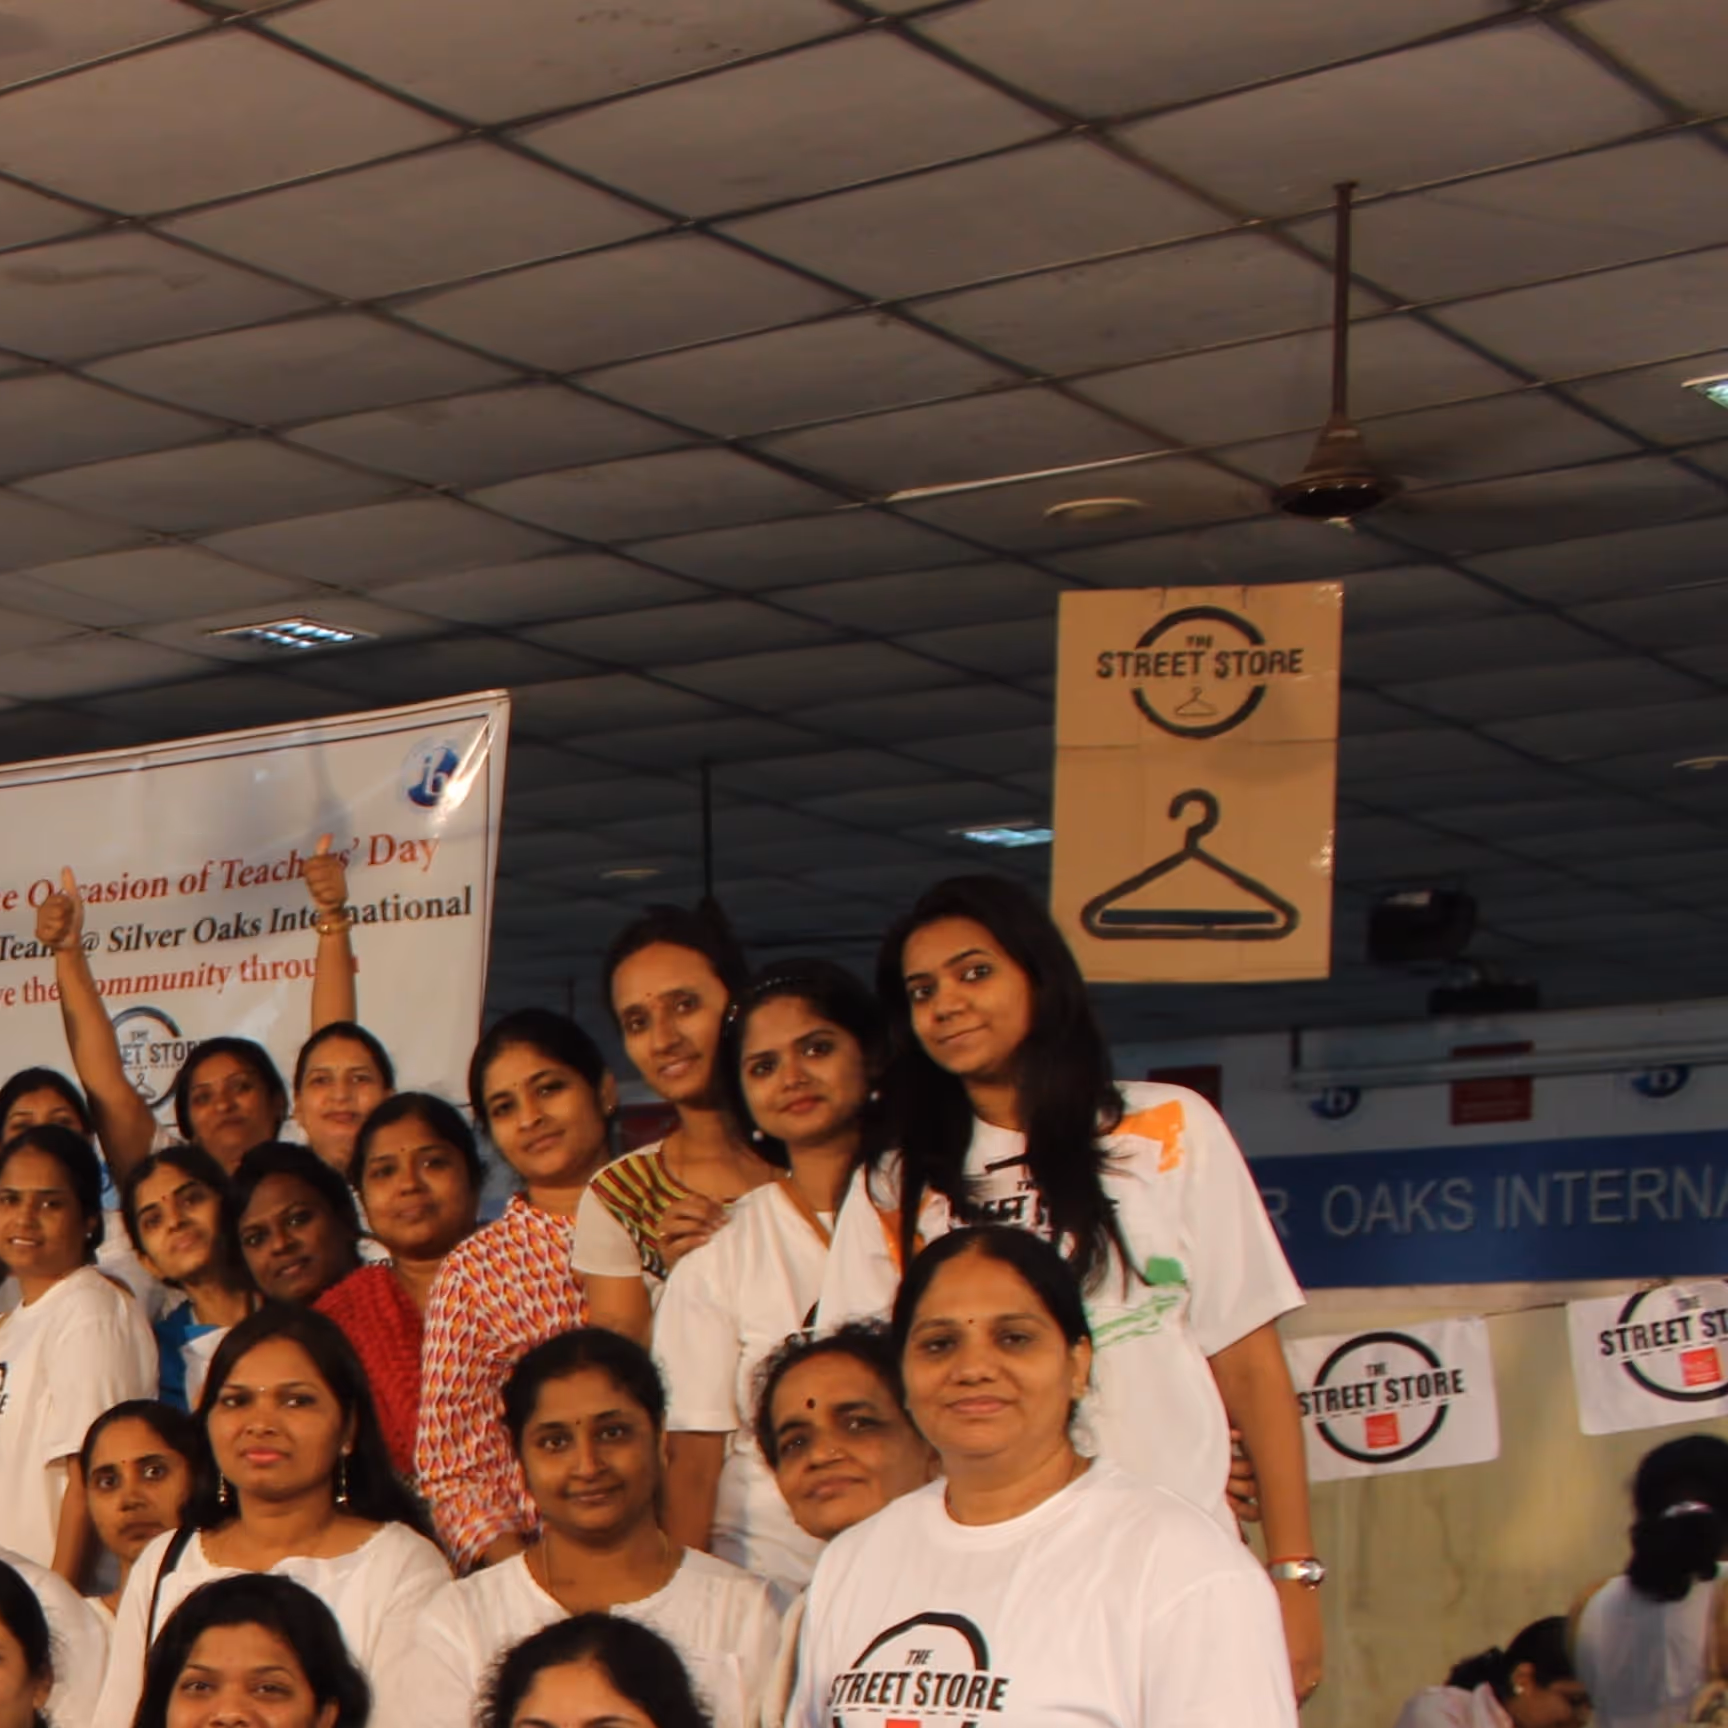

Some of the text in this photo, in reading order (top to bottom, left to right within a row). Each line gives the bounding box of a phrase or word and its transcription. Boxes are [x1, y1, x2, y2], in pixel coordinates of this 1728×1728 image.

[1186, 635, 1213, 648] THE
[1096, 648, 1305, 679] STREET STORE
[177, 861, 212, 895] of
[367, 833, 440, 873] Day
[79, 931, 100, 957] @
[108, 918, 185, 953] Silver
[194, 912, 262, 947] Oaks
[23, 975, 61, 1004] the
[91, 962, 232, 1000] ommunity
[1322, 1177, 1474, 1237] OAKS
[1599, 1316, 1692, 1357] STREET
[1365, 1362, 1386, 1376] THE
[1297, 1368, 1465, 1417] STREET STORE
[907, 1649, 933, 1665] THE
[827, 1671, 1010, 1712] STREET STORE
